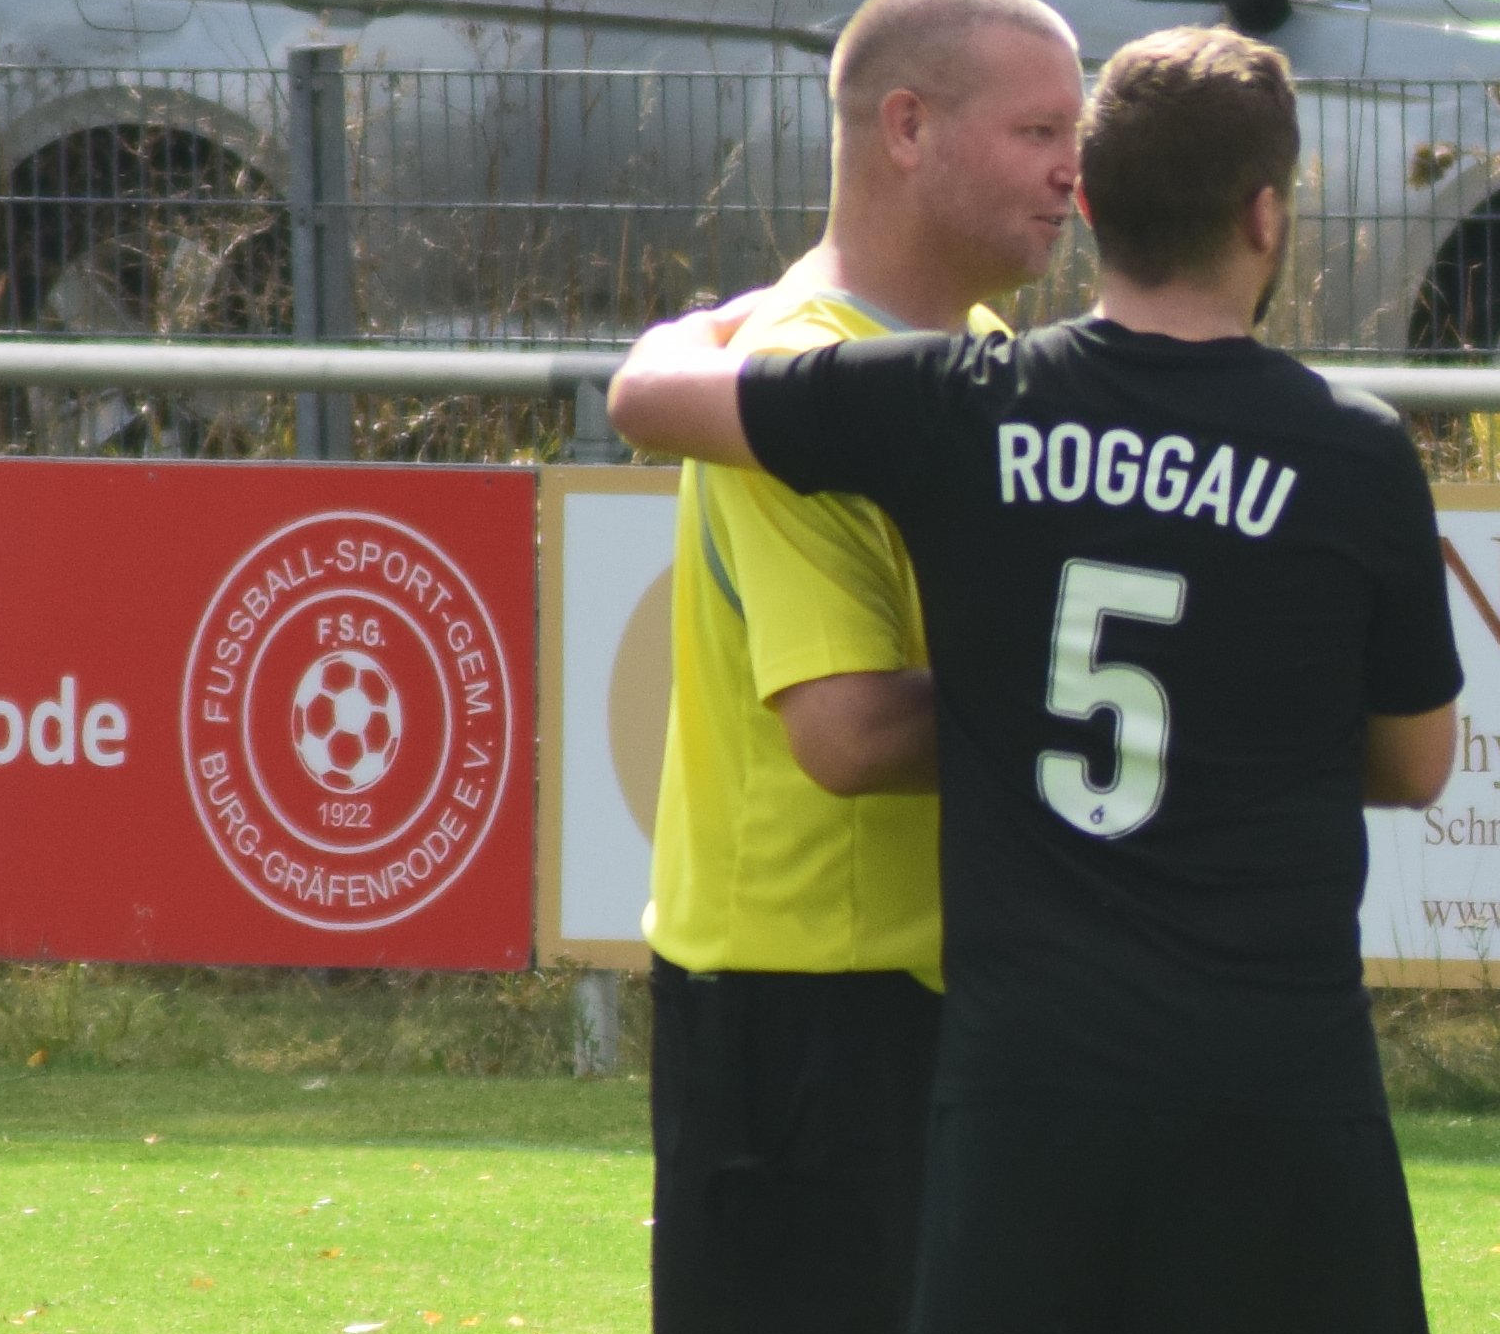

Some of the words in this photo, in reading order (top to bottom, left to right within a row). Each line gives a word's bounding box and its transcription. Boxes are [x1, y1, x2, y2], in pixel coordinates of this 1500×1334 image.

[998, 423, 1297, 538] ROGGAU
[318, 614, 385, 649] F.S.G.
[1036, 558, 1187, 839] 5
[200, 749, 468, 909] BURG-GRÄFENRODE
[317, 801, 372, 828] 1922
